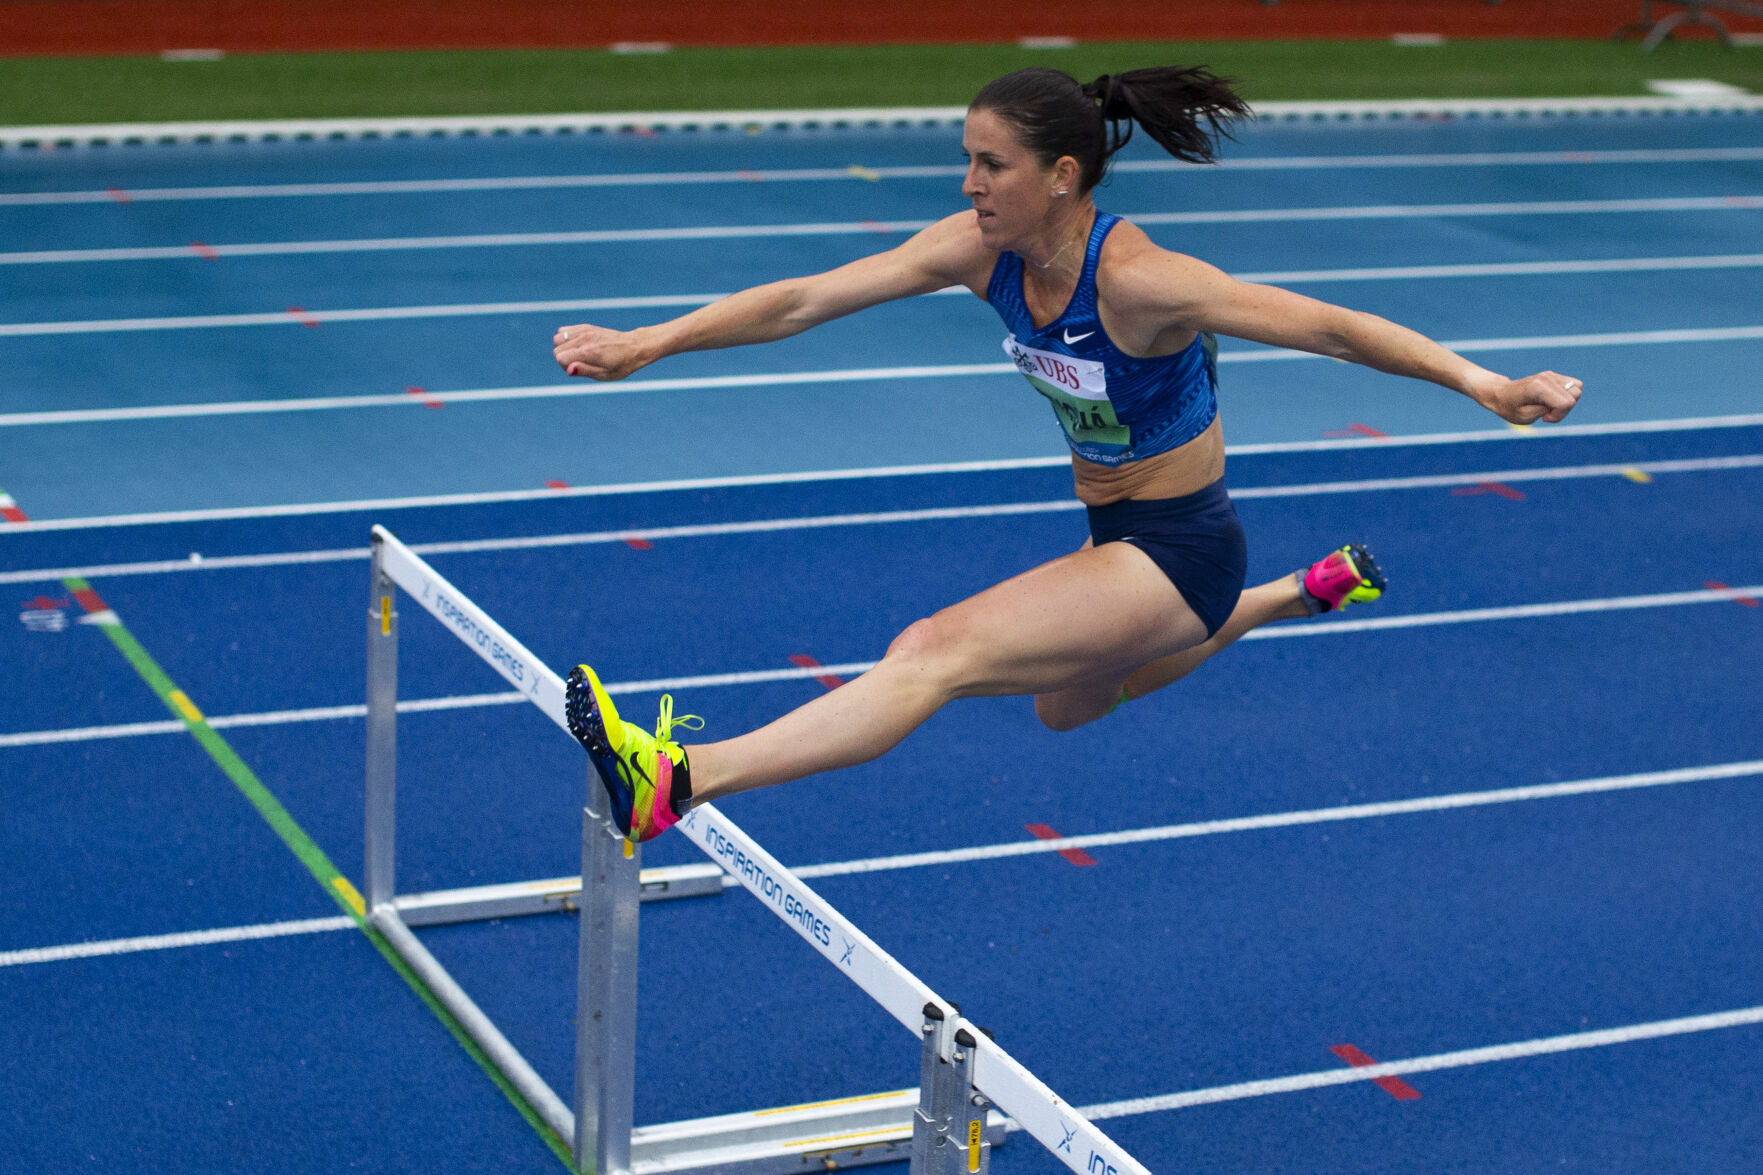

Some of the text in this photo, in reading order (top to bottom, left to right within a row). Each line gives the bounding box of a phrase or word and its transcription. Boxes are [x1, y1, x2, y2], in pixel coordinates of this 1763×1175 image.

[1034, 355, 1080, 389] UBS
[705, 824, 831, 947] INSPIRATION GAMES
